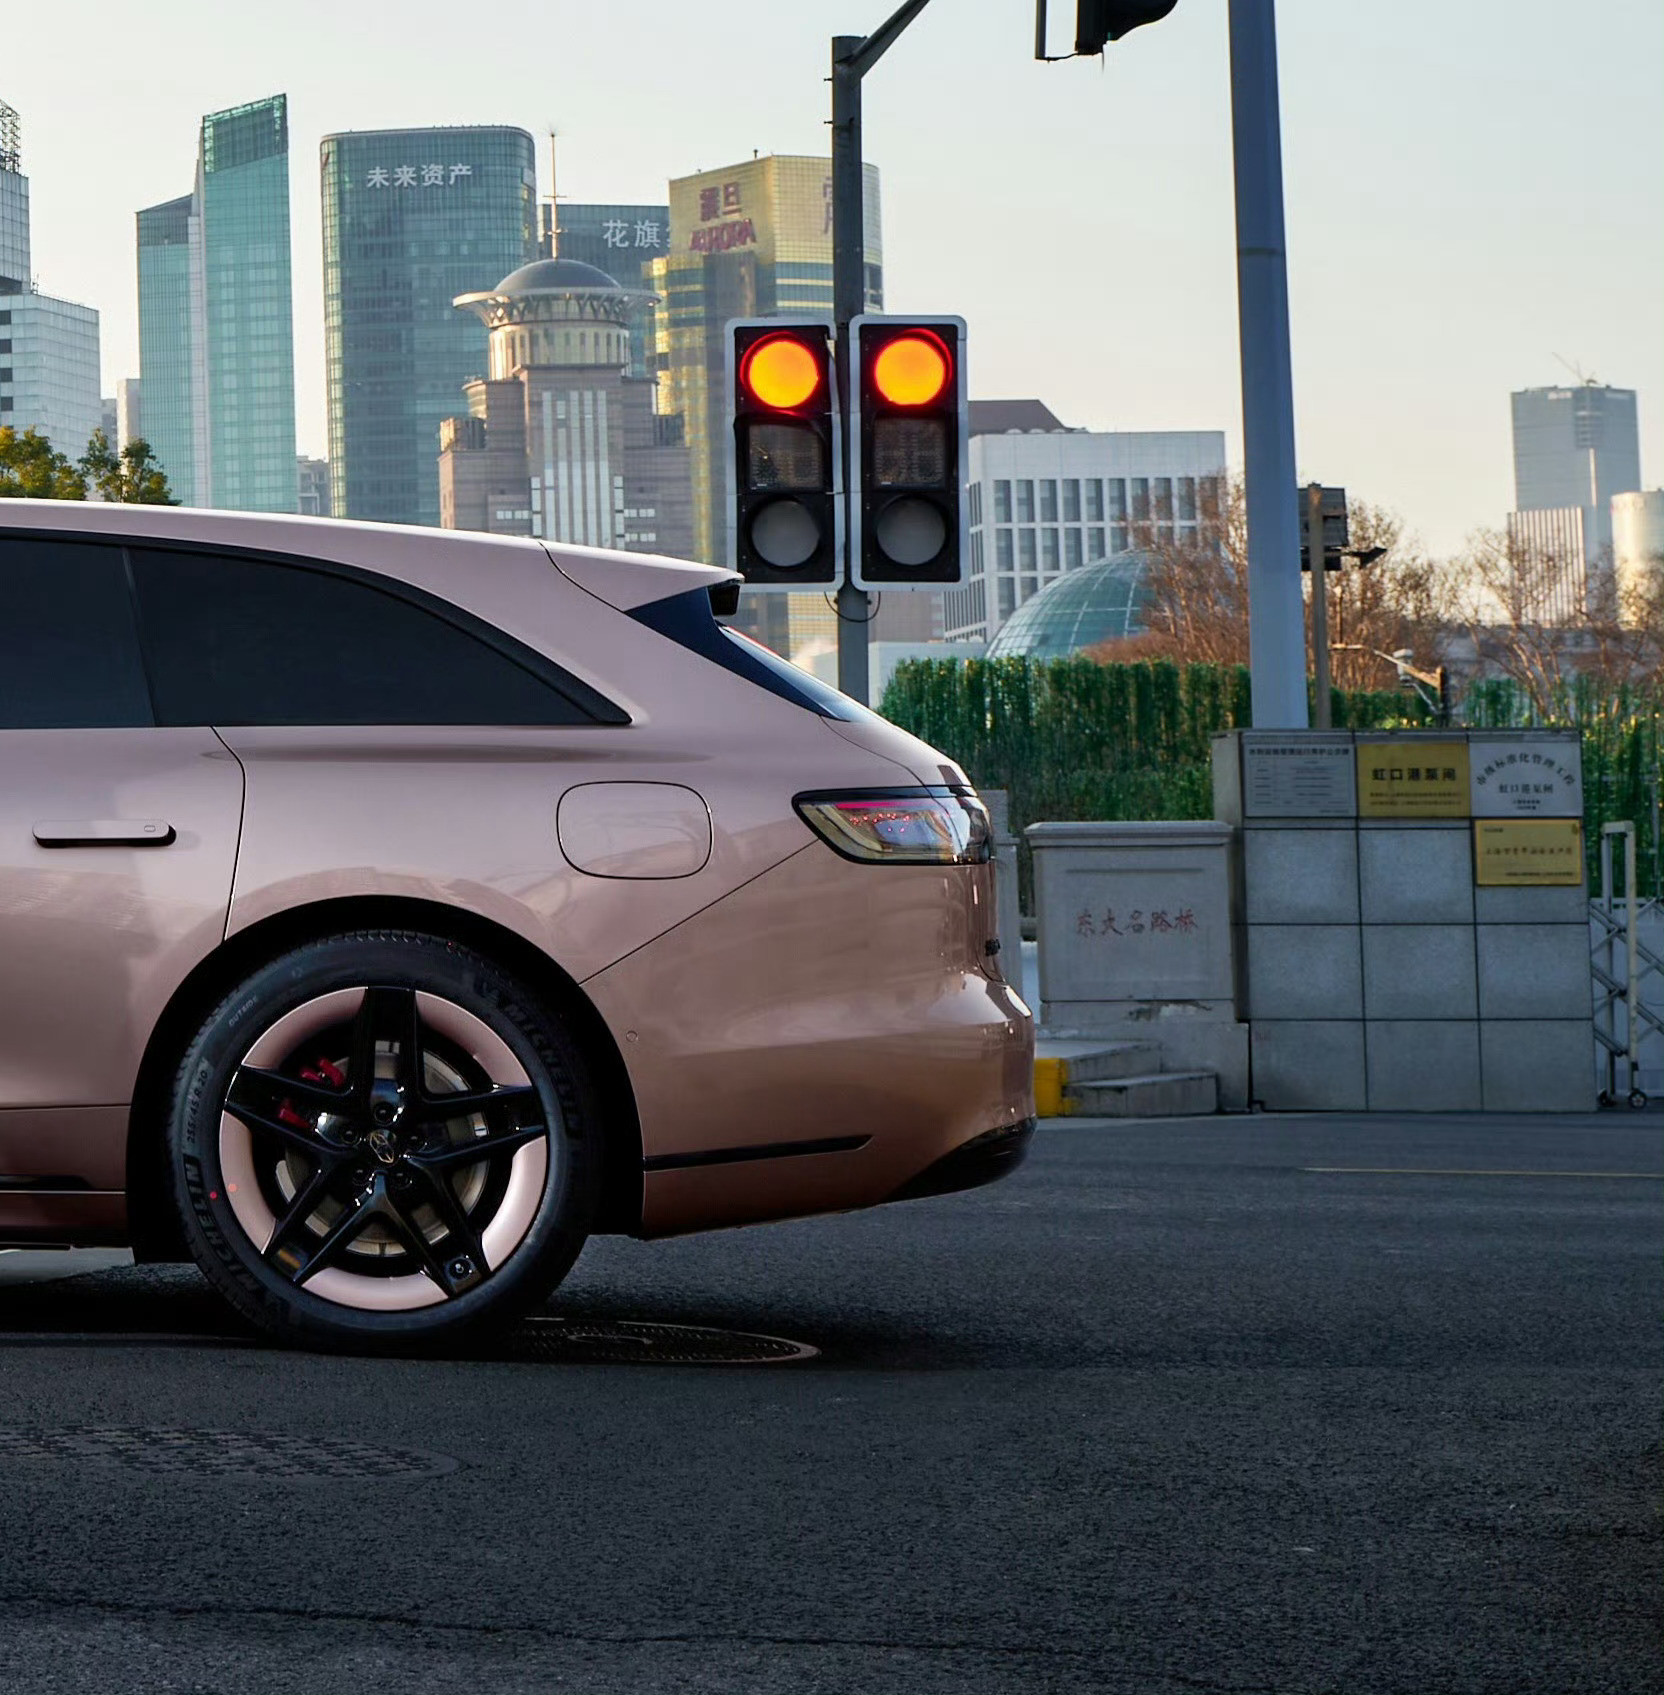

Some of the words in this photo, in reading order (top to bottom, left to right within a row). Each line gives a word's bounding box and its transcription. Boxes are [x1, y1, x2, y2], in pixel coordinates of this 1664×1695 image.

[366, 163, 473, 188] 未来资产
[699, 181, 742, 222] 震旦
[602, 219, 671, 248] 花旗
[689, 218, 757, 253] AURORA
[185, 1161, 260, 1294] MICHELIN
